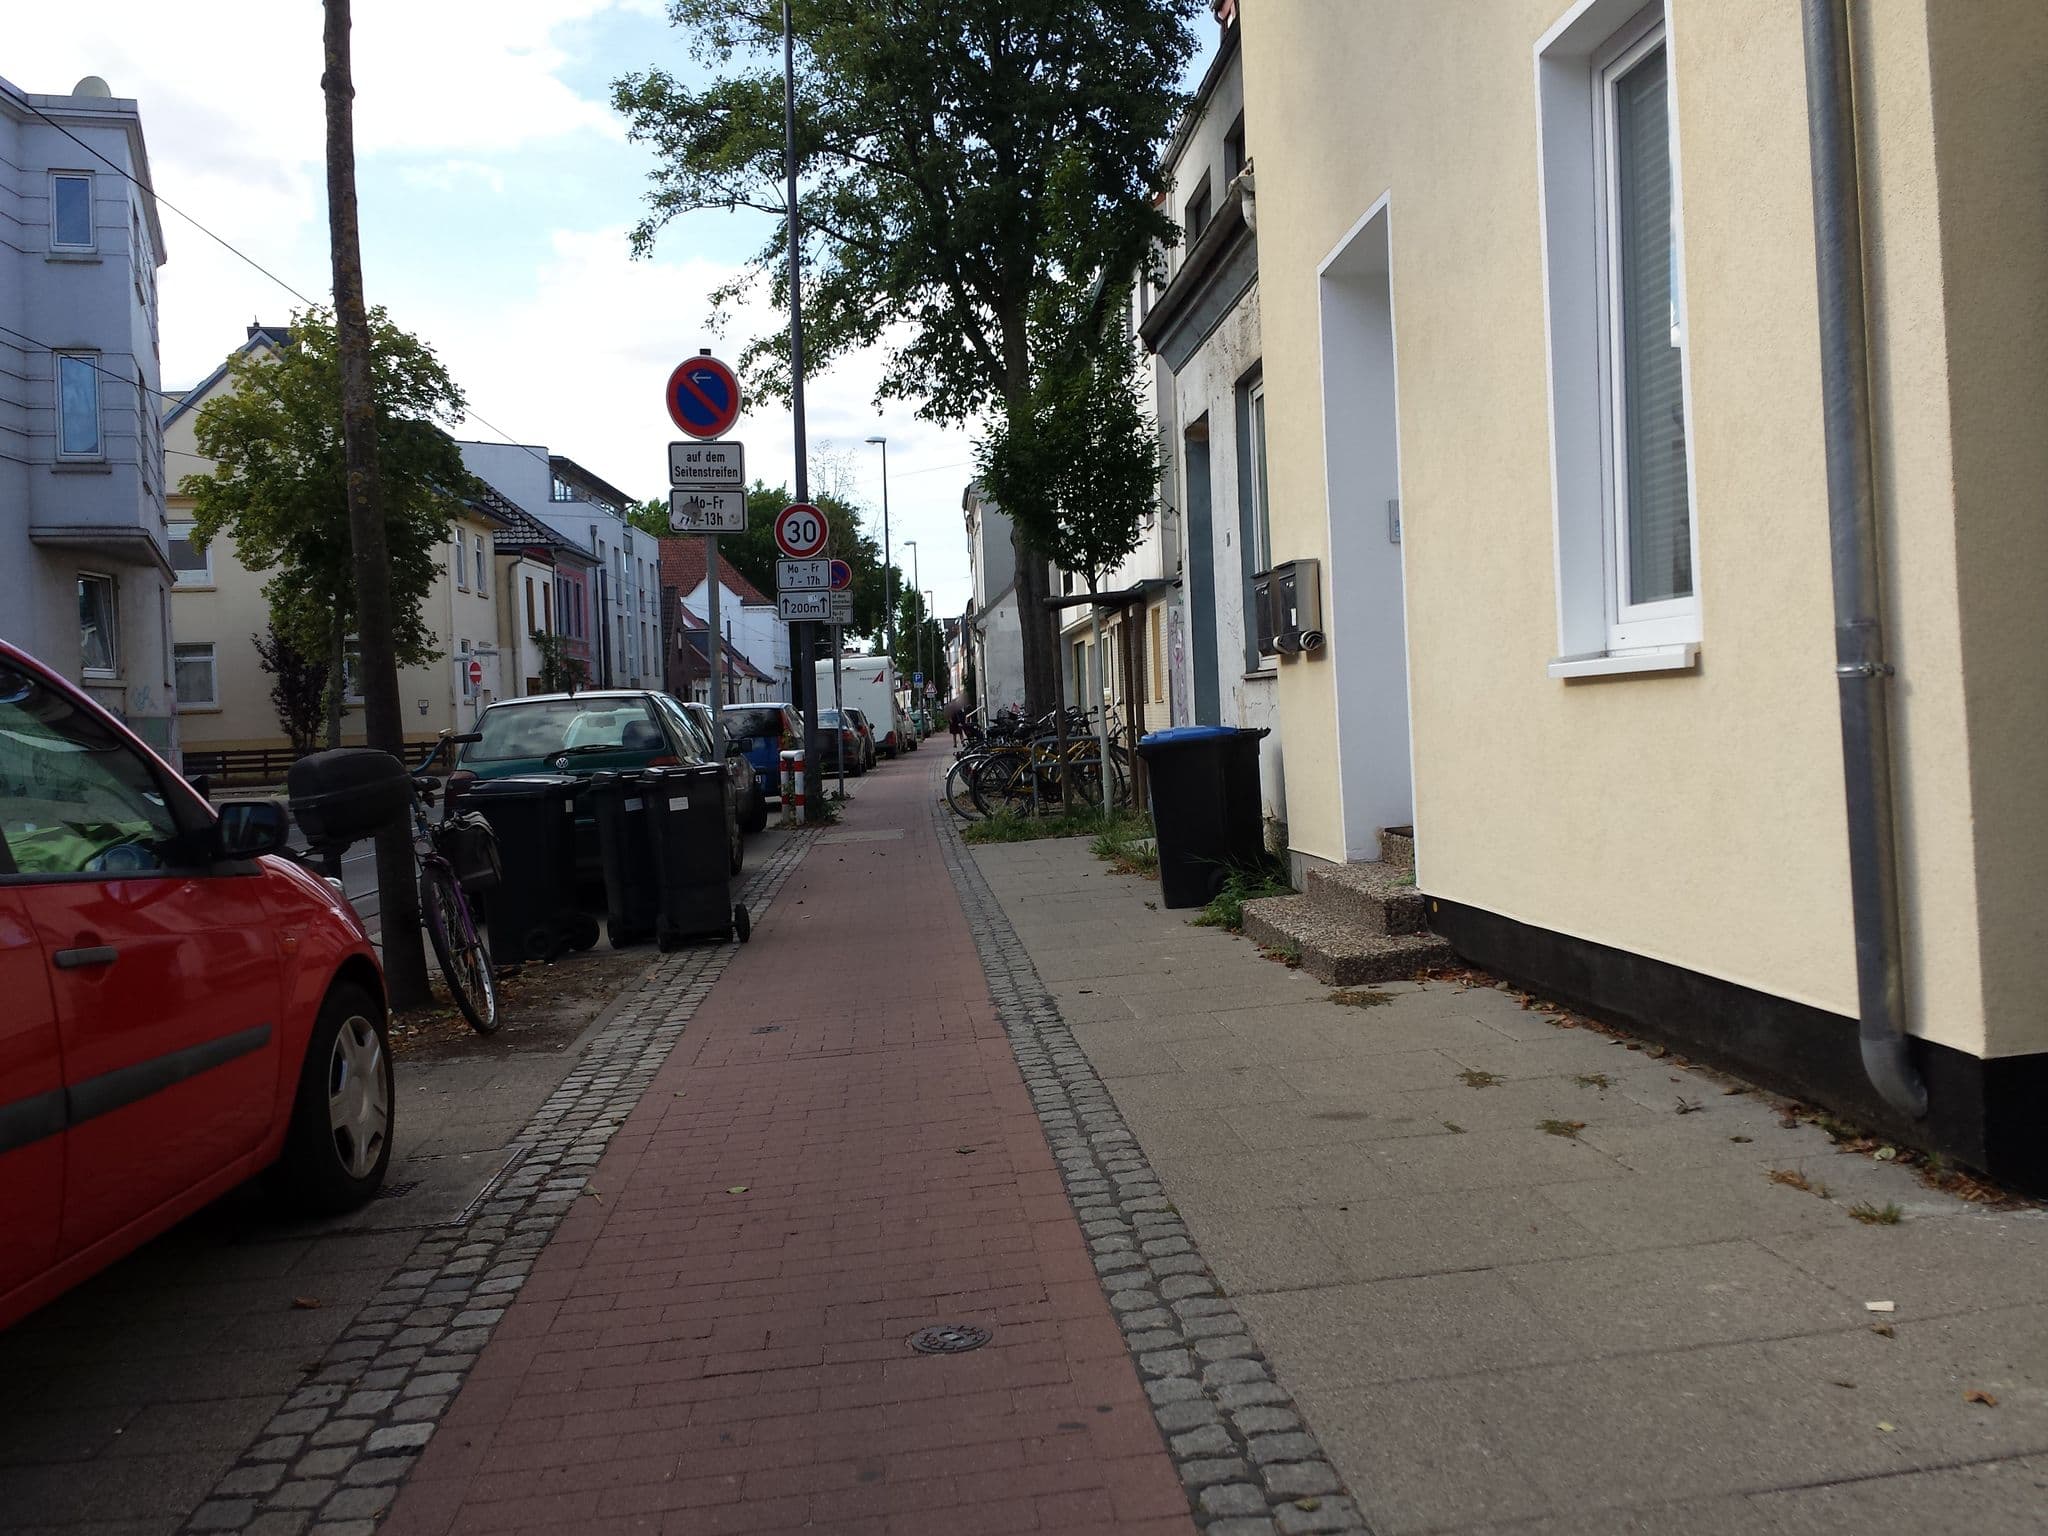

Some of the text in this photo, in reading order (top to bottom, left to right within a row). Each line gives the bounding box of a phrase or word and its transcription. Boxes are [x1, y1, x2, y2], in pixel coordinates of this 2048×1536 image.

[686, 451, 725, 462] auf dem
[675, 466, 738, 477] Seitenstreifen
[787, 520, 817, 543] 30
[787, 564, 799, 574] Mo
[811, 563, 820, 572] Fr
[789, 577, 794, 586] 7
[807, 576, 820, 585] 17h
[791, 603, 820, 613] 200m
